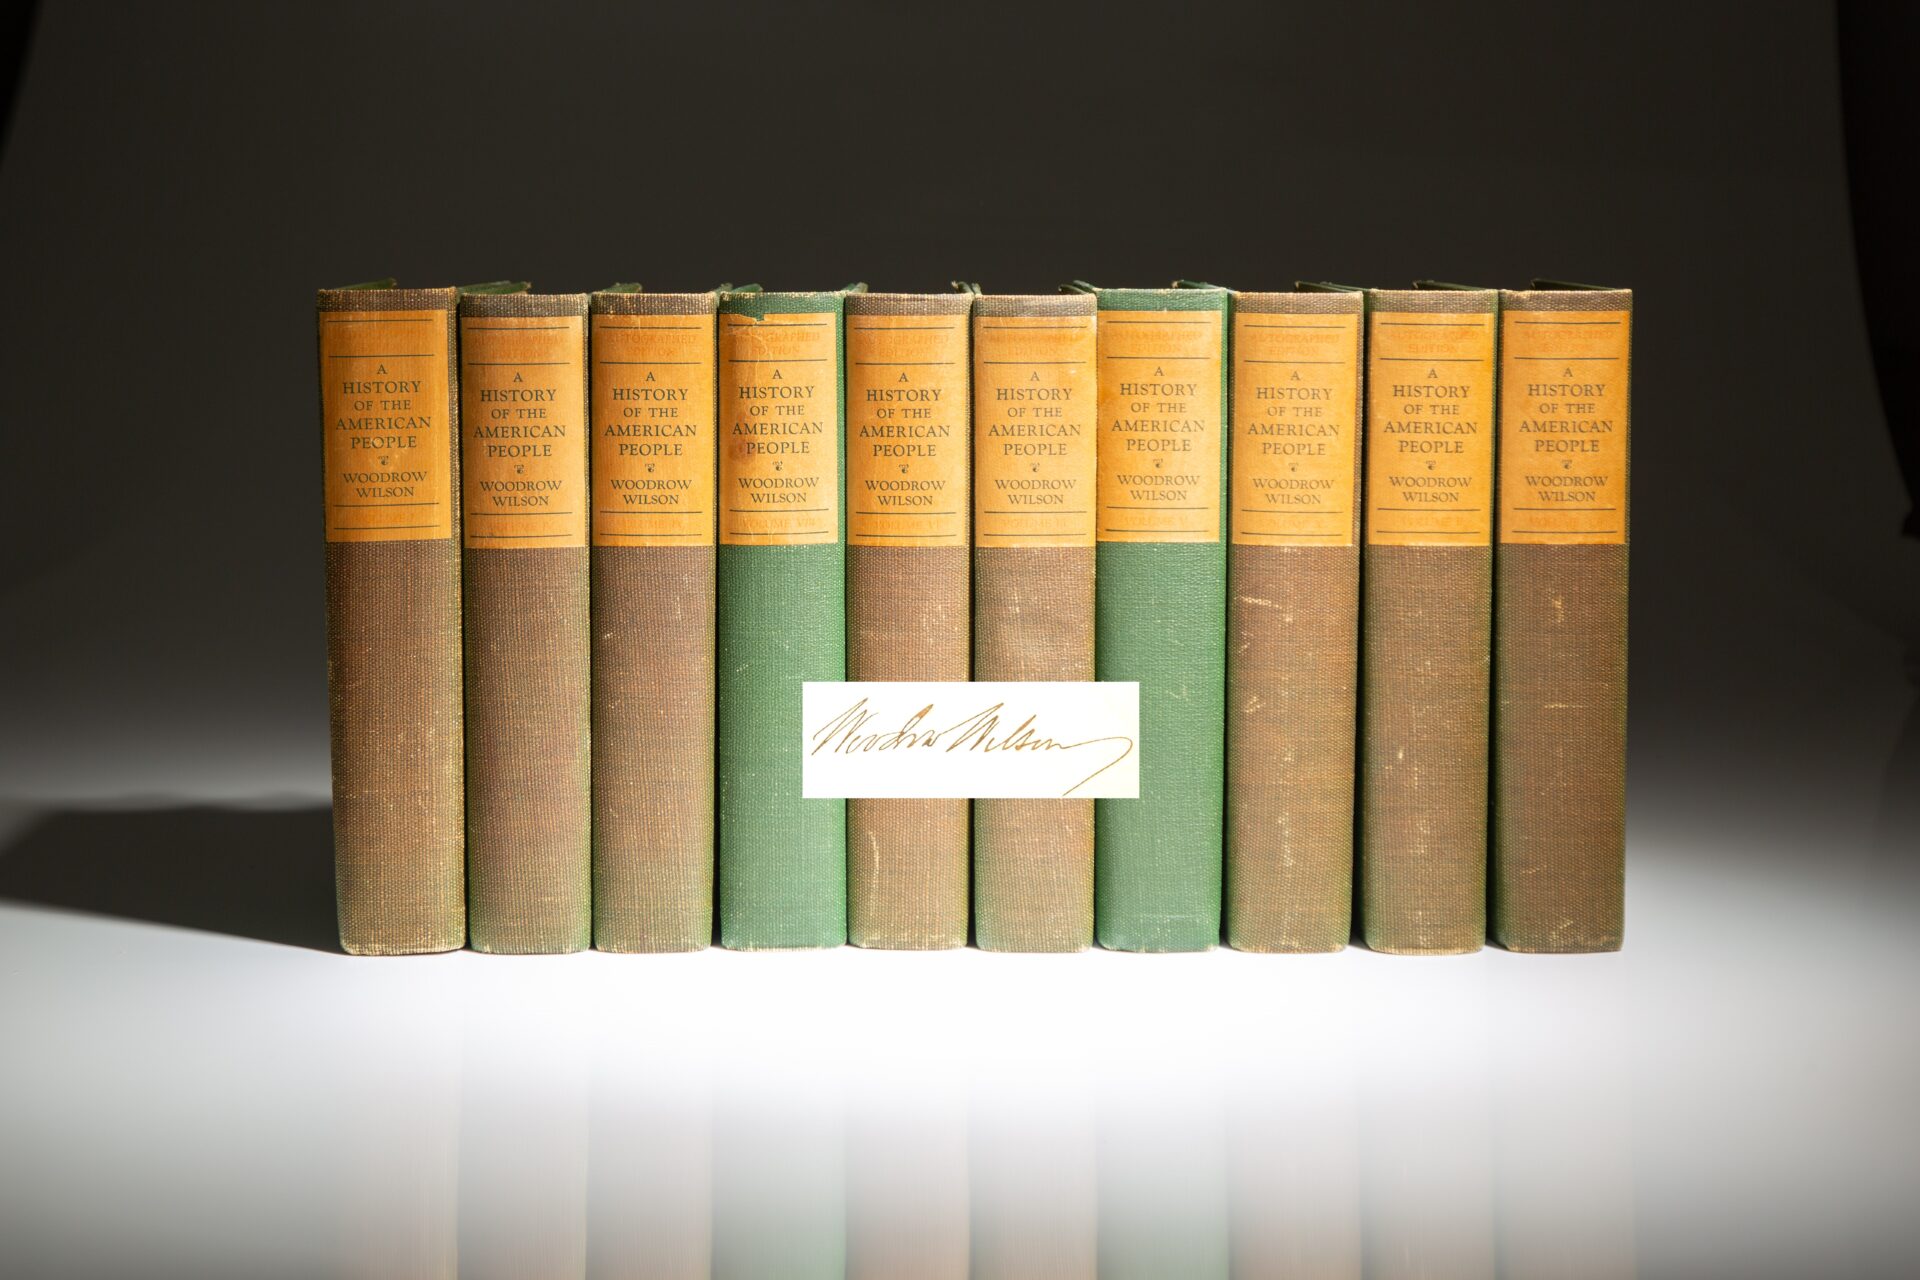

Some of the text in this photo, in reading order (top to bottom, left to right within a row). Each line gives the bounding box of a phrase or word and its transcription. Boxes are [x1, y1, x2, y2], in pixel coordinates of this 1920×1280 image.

[376, 363, 388, 375] A
[772, 369, 783, 380] A
[1153, 366, 1165, 377] A
[1289, 369, 1301, 380] A
[1427, 369, 1438, 379] A
[1562, 367, 1574, 378] A
[512, 372, 524, 383] A
[645, 371, 656, 382] A
[897, 372, 909, 383] A
[1029, 371, 1041, 381] A
[343, 380, 421, 394] HISTORY
[739, 385, 814, 400] HISTORY
[1119, 383, 1197, 396] HISTORY
[1392, 385, 1470, 398] HISTORY
[1527, 384, 1605, 397] HISTORY
[480, 389, 556, 402] HISTORY
[612, 388, 688, 401] HISTORY
[866, 389, 940, 402] HISTORY
[996, 388, 1072, 401] HISTORY
[1256, 387, 1332, 400] HISTORY
[353, 399, 411, 411] OF THE
[749, 405, 805, 417] OF THE
[1130, 402, 1186, 413] OF THE
[1266, 405, 1322, 417] OF THE
[1403, 404, 1460, 415] OF THE
[1538, 403, 1595, 414] OF THE
[490, 408, 547, 420] OF THE
[623, 407, 678, 418] OF THE
[876, 408, 931, 419] OF THE
[1007, 407, 1063, 418] OF THE
[335, 416, 431, 431] AMERICAN
[732, 422, 823, 436] AMERICAN
[1111, 419, 1204, 432] AMERICAN
[1247, 423, 1340, 436] AMERICAN
[1384, 421, 1477, 435] AMERICAN
[1519, 420, 1613, 434] AMERICAN
[473, 425, 566, 439] AMERICAN
[604, 424, 697, 438] AMERICAN
[859, 425, 950, 438] AMERICAN
[988, 424, 1081, 437] AMERICAN
[351, 435, 417, 450] PEOPLE
[746, 441, 810, 455] PEOPLE
[1126, 439, 1191, 452] PEOPLE
[1261, 442, 1325, 455] PEOPLE
[1399, 440, 1464, 454] PEOPLE
[1535, 439, 1600, 453] PEOPLE
[487, 444, 552, 458] PEOPLE
[619, 443, 683, 457] PEOPLE
[872, 444, 936, 457] PEOPLE
[1003, 443, 1067, 456] PEOPLE
[343, 471, 427, 484] WOODROW
[738, 477, 819, 489] WOODROW
[1116, 474, 1200, 485] WOODROW
[1253, 478, 1334, 489] WOODROW
[1388, 476, 1472, 487] WOODROW
[1525, 476, 1608, 487] WOODROW
[479, 480, 562, 492] WOODROW
[610, 479, 692, 490] WOODROW
[865, 480, 946, 491] WOODROW
[994, 479, 1074, 490] WOODROW
[355, 486, 414, 498] WILSON
[1130, 490, 1187, 501] WILSON
[1402, 491, 1459, 502] WILSON
[1538, 491, 1596, 502] WILSON
[491, 495, 549, 507] WILSON
[623, 494, 679, 505] WILSON
[751, 493, 807, 504] WILSON
[877, 495, 933, 506] WILSON
[1007, 494, 1064, 505] WILSON
[1266, 494, 1321, 505] WILSON
